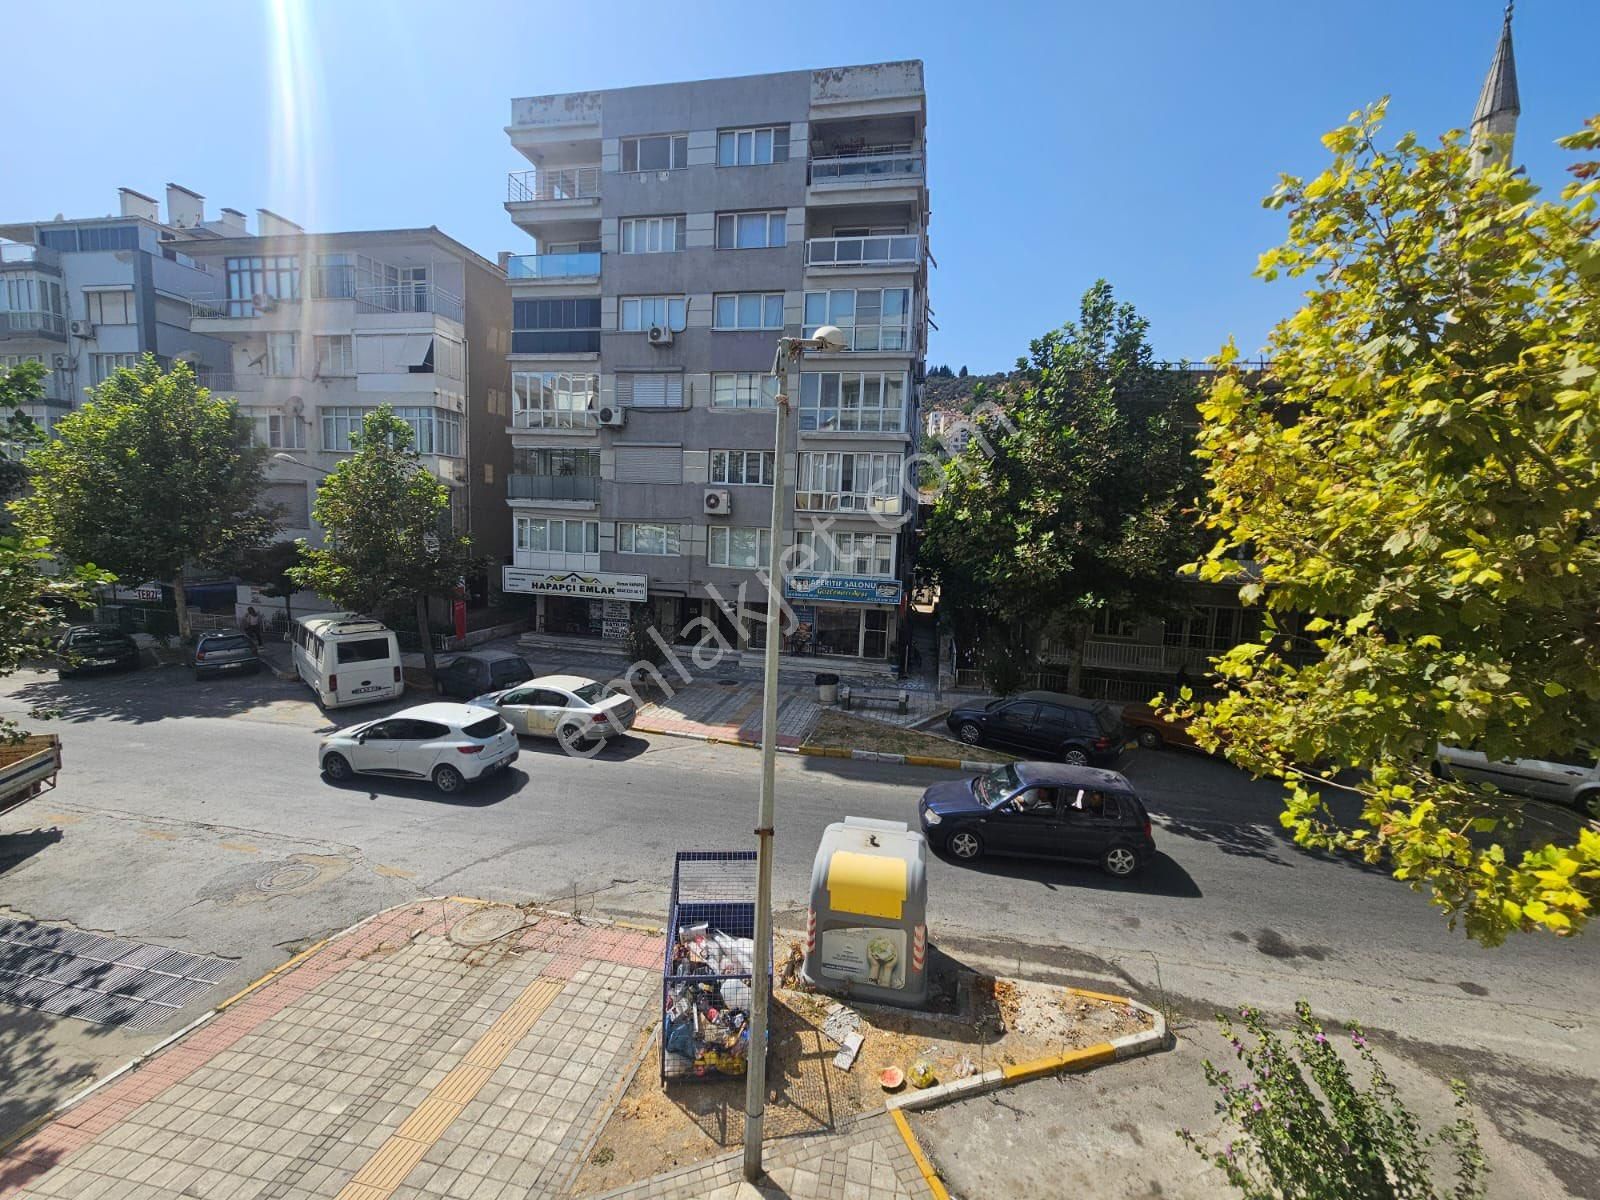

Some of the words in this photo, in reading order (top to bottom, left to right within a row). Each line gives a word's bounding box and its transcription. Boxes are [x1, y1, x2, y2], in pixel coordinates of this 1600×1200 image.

[531, 582, 576, 592] HAPAPÇI
[579, 585, 616, 595] EMLAK
[844, 580, 877, 589] SALONU
